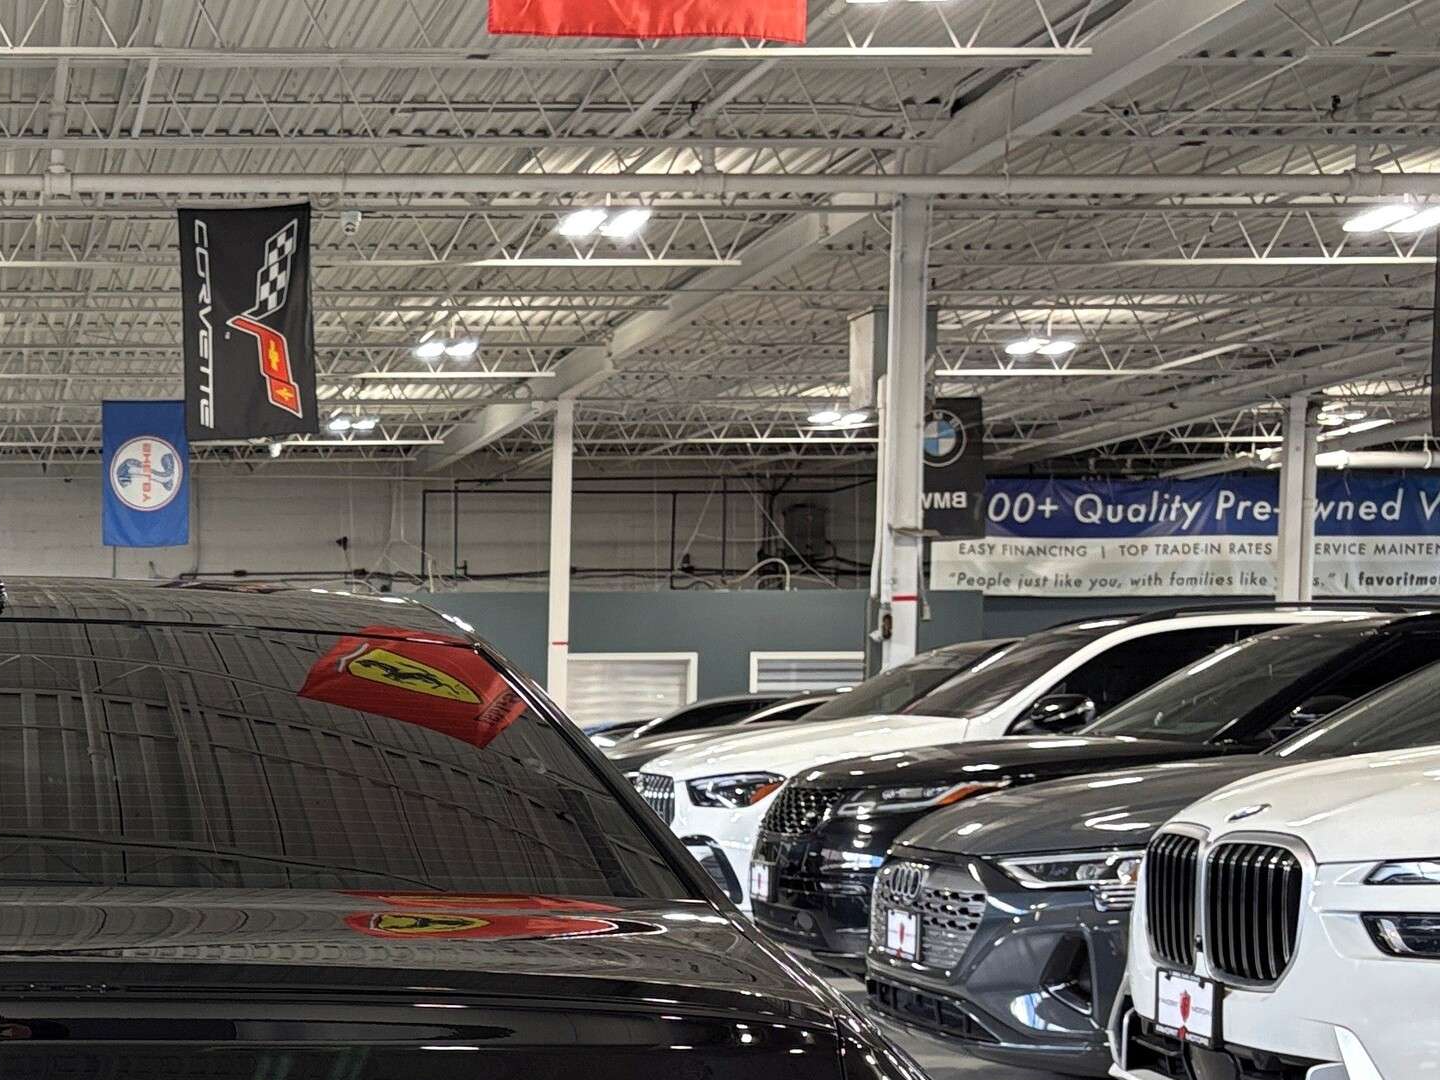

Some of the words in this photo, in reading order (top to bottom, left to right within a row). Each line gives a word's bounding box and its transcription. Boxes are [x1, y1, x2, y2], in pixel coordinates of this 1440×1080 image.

[195, 219, 215, 429] CORVETTE
[1074, 490, 1201, 530] Quality
[1215, 487, 1403, 521] Pre-wned
[959, 542, 996, 556] EASY
[1001, 543, 1087, 558] FINANCING
[1119, 544, 1148, 557] TOP
[1155, 542, 1221, 557] TRADE-IN
[1229, 542, 1272, 556] RATES
[1315, 542, 1366, 556] ERVICE
[1018, 572, 1048, 590] just
[1054, 572, 1082, 588] like
[1088, 576, 1122, 591] you,
[1130, 573, 1162, 587] with
[1170, 572, 1233, 587] families
[1240, 571, 1267, 586] like
[1359, 571, 1440, 586] favoritmo
